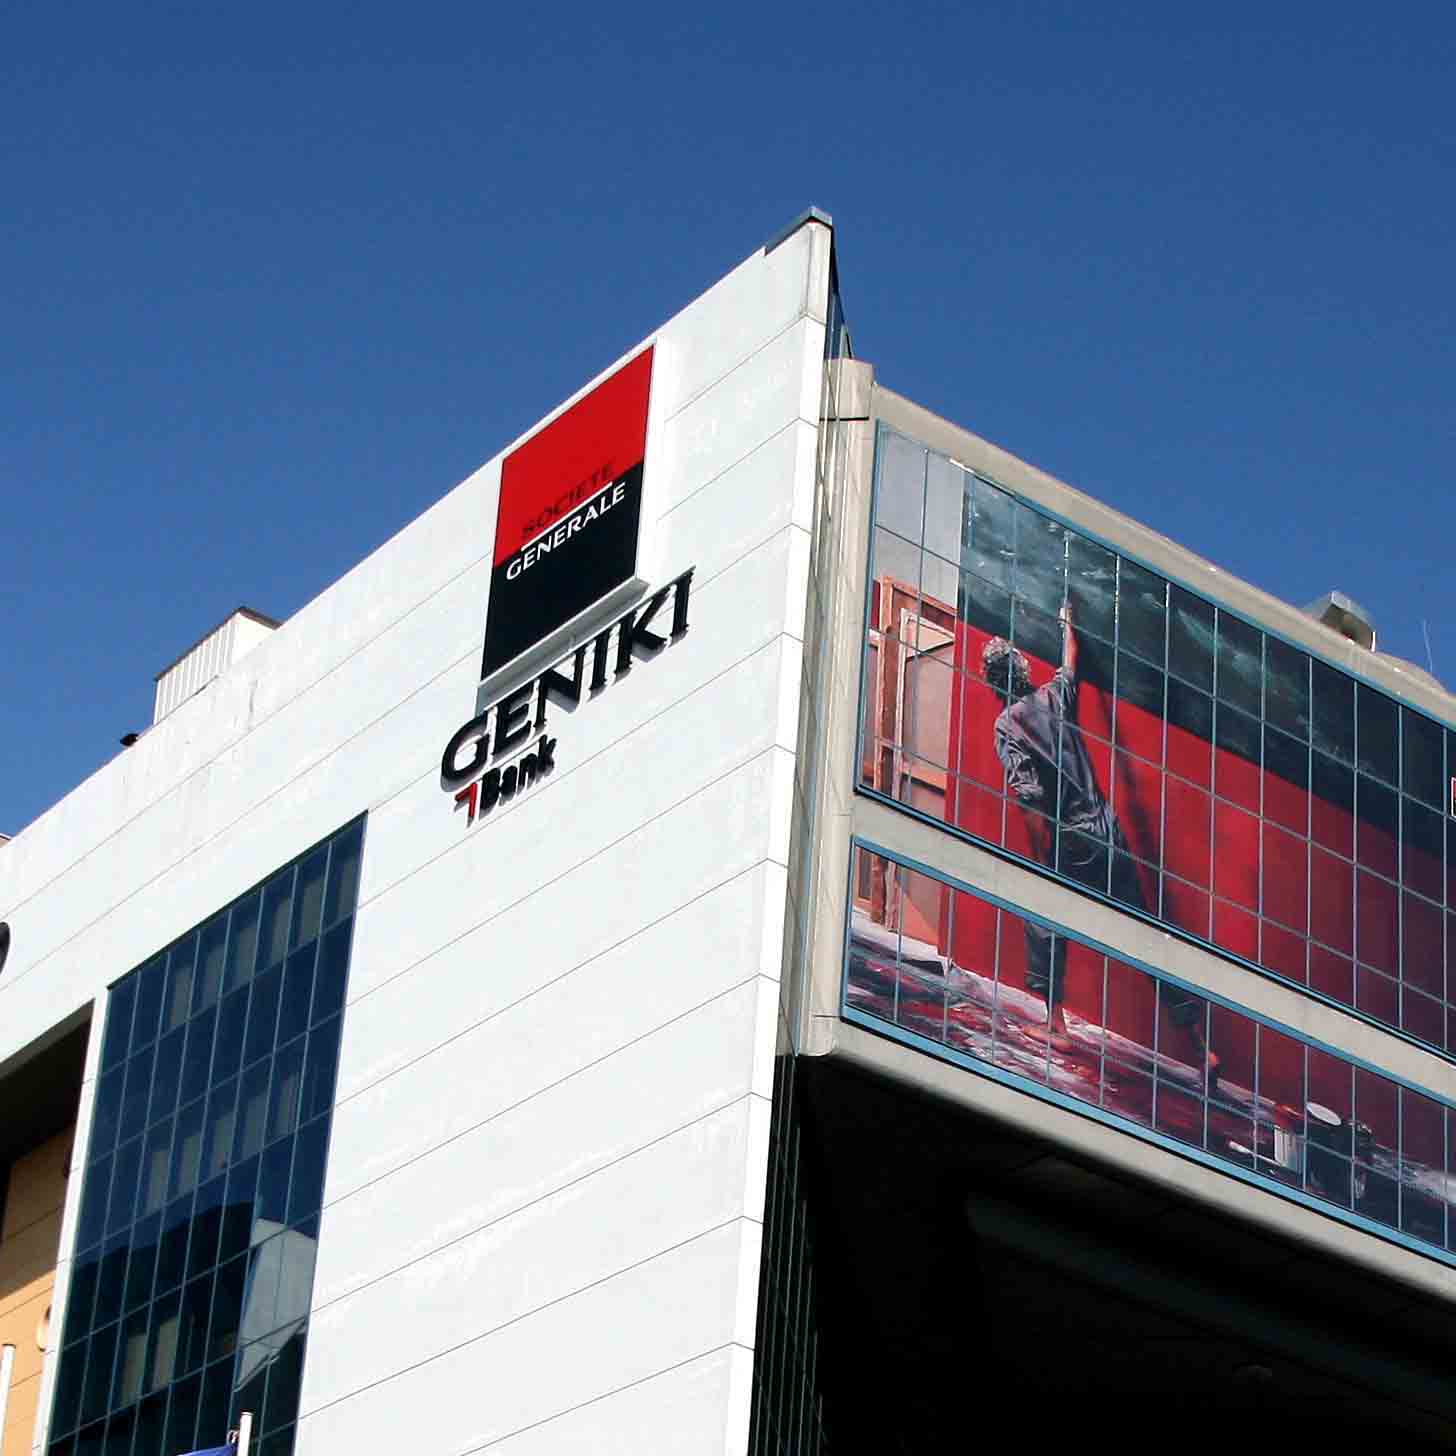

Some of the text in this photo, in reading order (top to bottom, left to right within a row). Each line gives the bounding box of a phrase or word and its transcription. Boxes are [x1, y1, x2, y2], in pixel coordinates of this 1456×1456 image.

[505, 481, 627, 581] GENERALE
[441, 566, 696, 792] GENIKI
[478, 734, 559, 815] Bank
